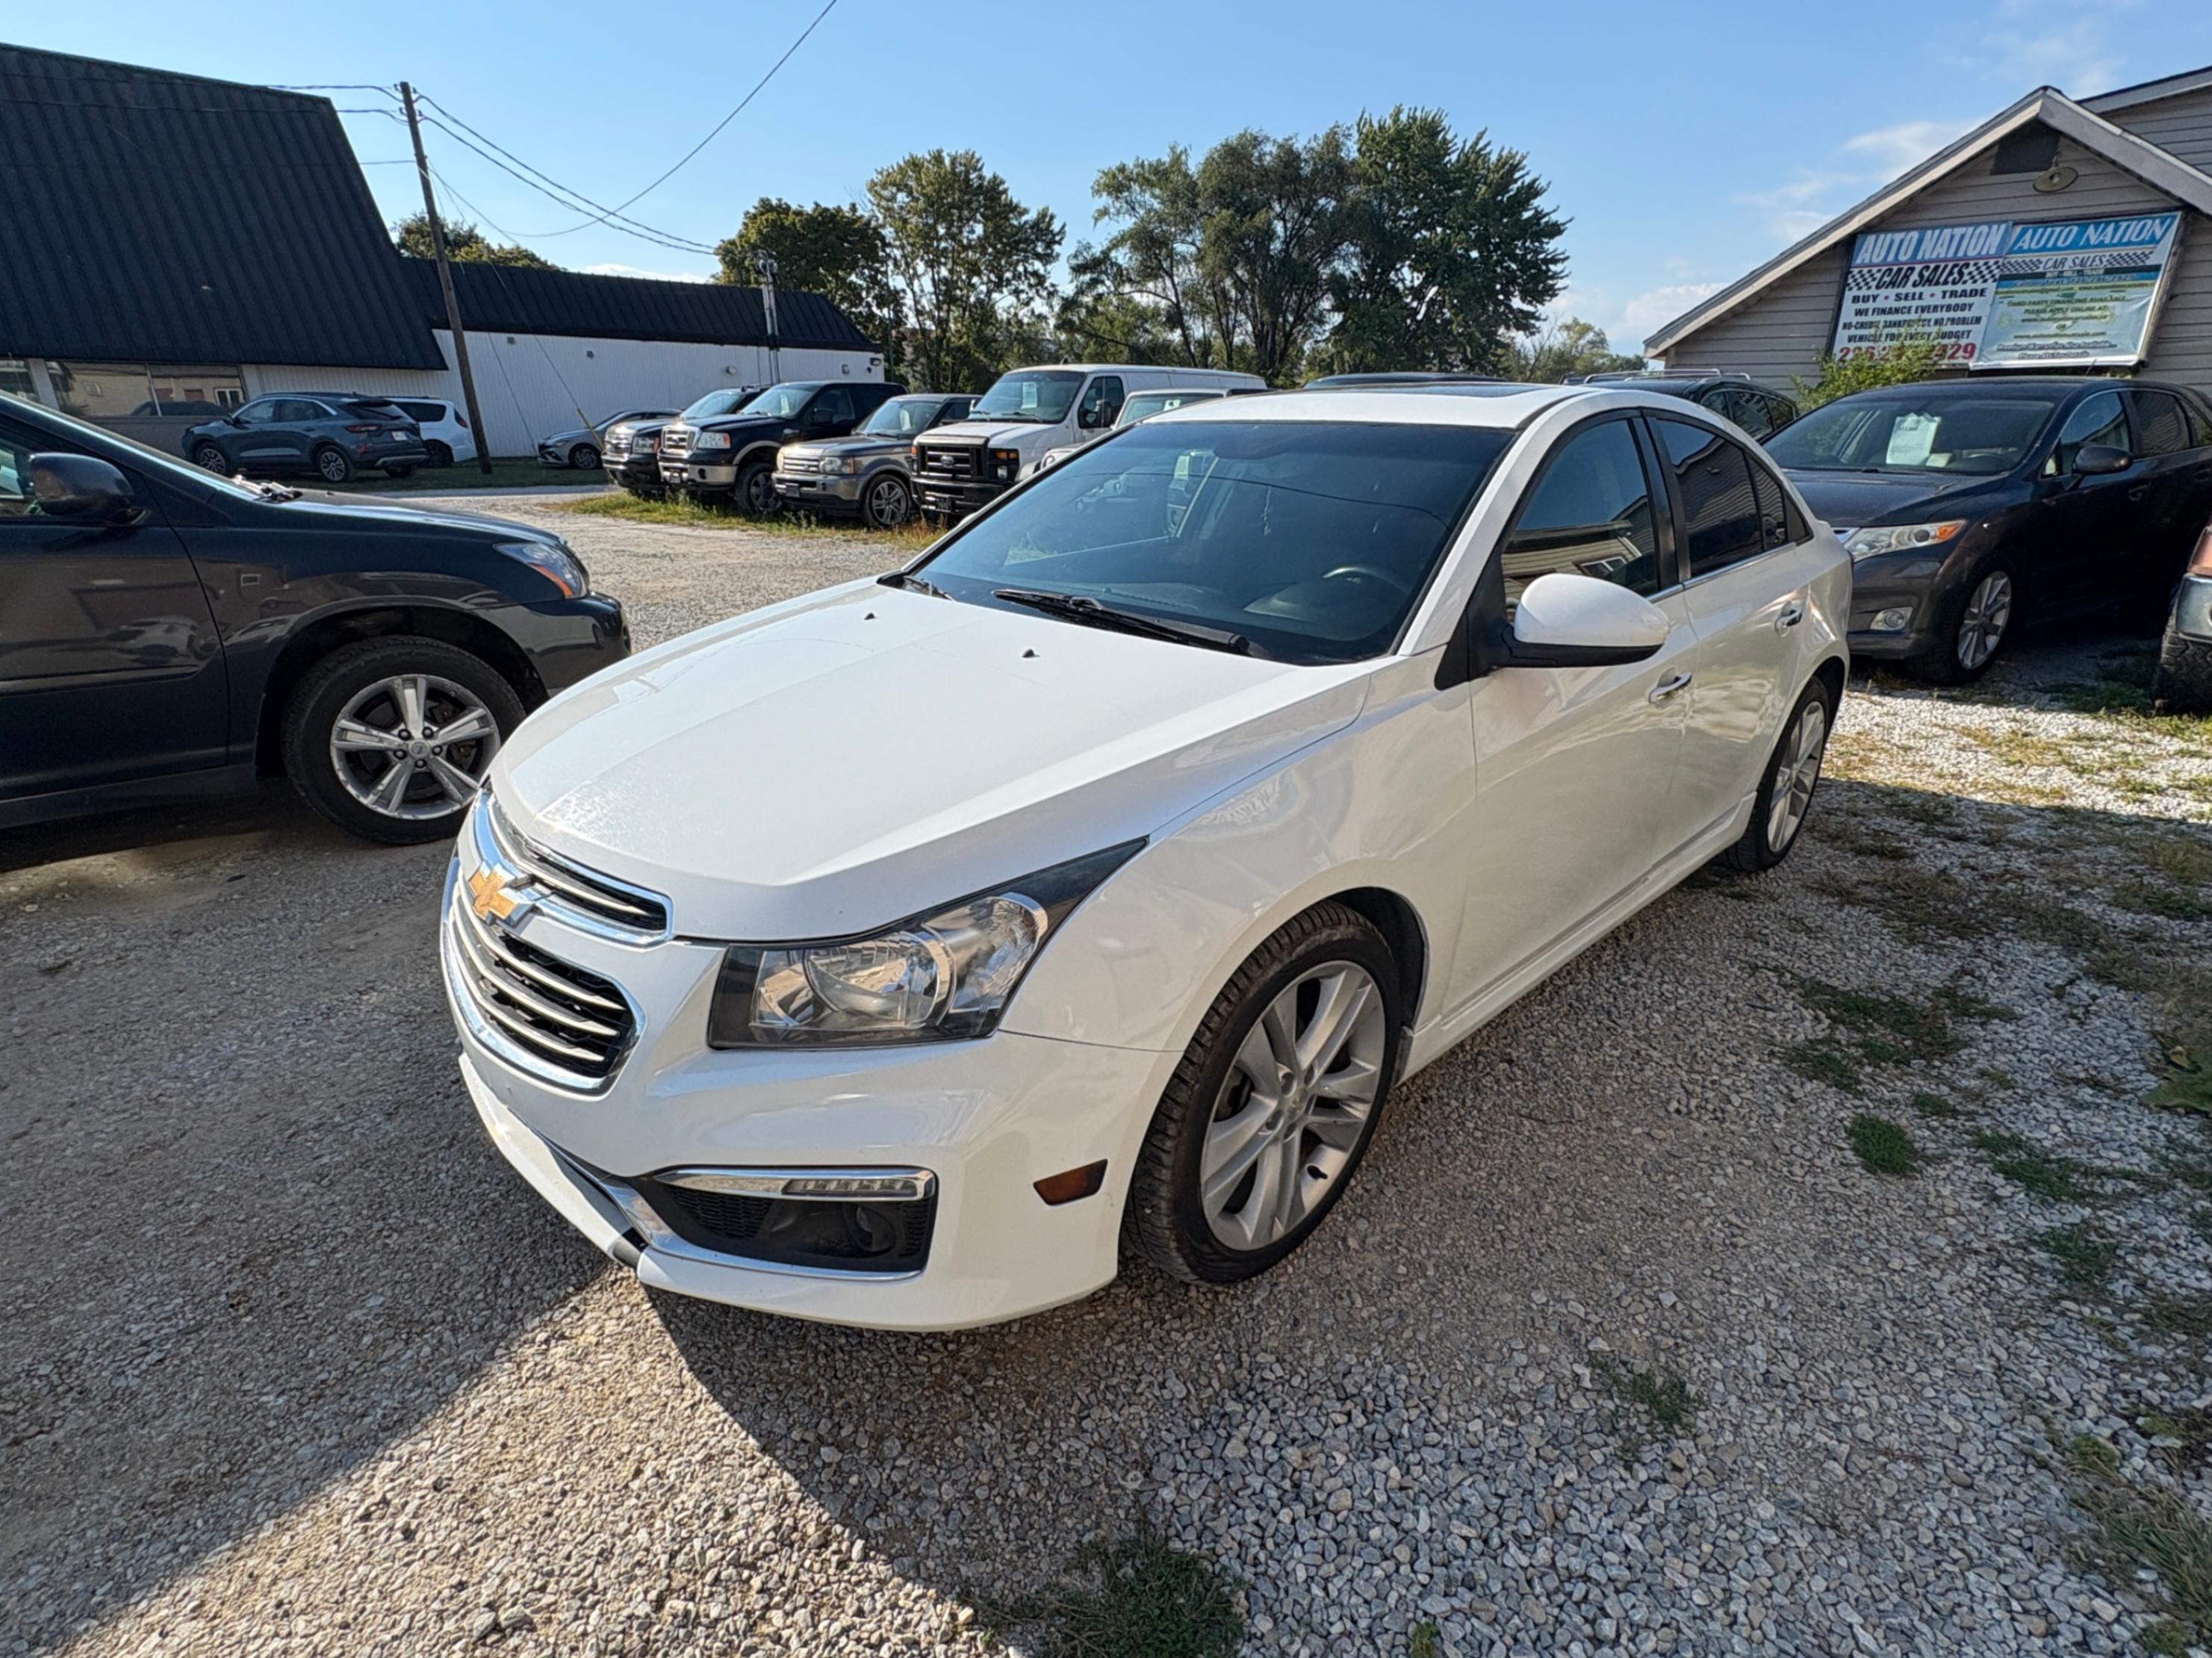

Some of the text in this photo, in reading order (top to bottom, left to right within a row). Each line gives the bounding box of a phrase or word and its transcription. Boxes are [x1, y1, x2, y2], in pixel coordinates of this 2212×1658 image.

[1856, 224, 2007, 264] AUTO NATION
[2014, 217, 2172, 250] AUTO NATION
[2042, 254, 2107, 270] CAR SALES
[1875, 262, 1971, 291] CAR SALES
[1851, 294, 1880, 304] BUY
[1894, 291, 1924, 302] SELL
[1941, 288, 1988, 299] TRADE
[1854, 302, 1975, 317] WE FINANCE EVERYBODY
